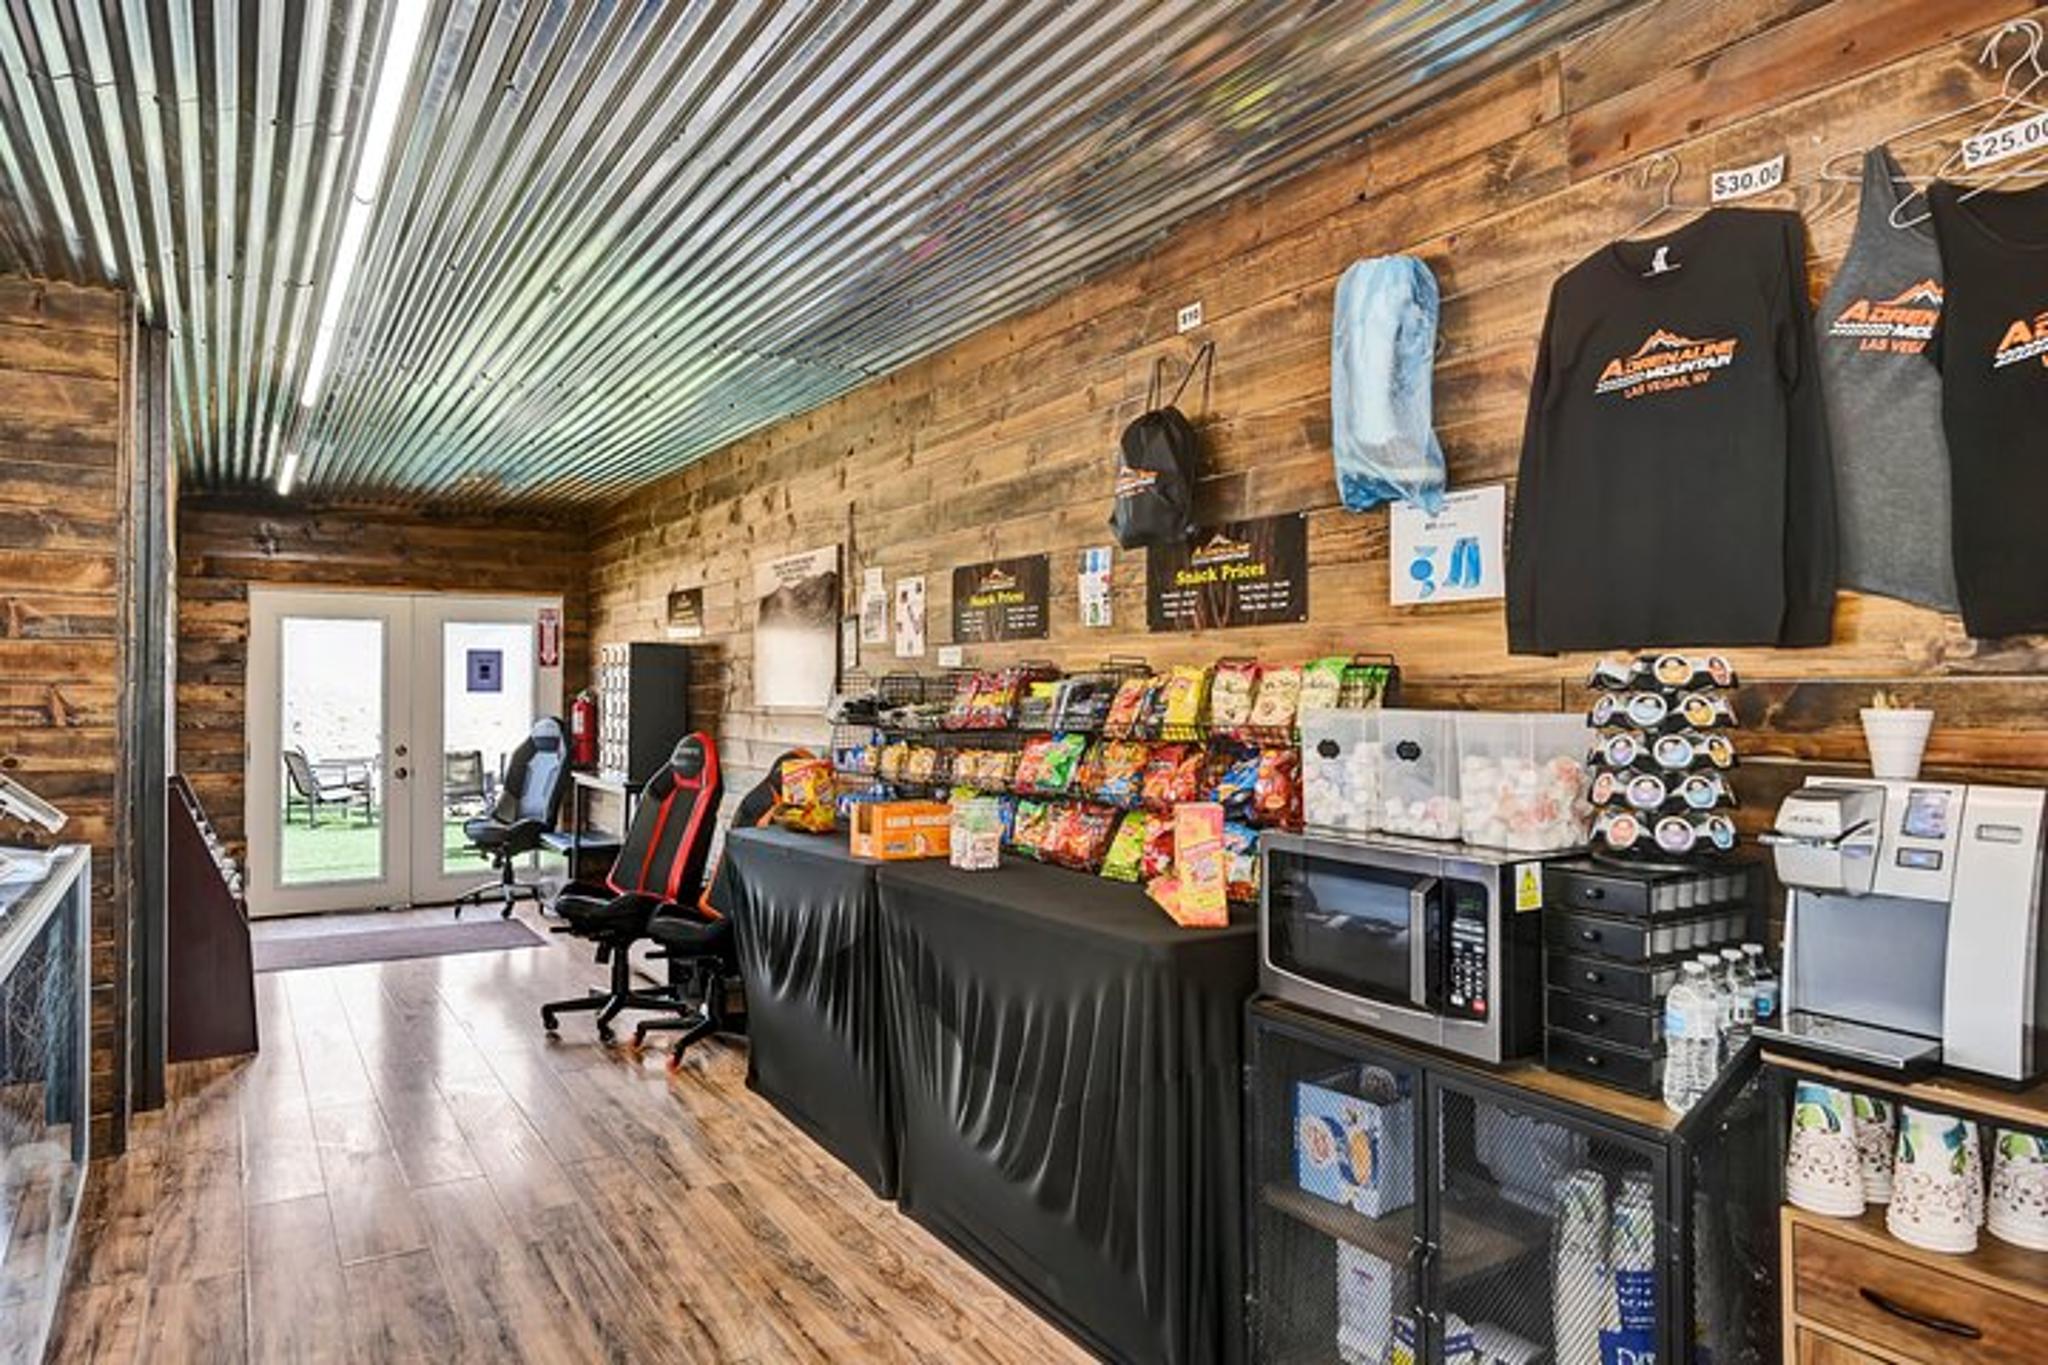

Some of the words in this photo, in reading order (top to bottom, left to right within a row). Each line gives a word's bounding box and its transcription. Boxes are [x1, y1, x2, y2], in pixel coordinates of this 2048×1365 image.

[1714, 162, 1779, 196] $30.00
[1859, 337, 1889, 351] LAS
[1175, 566, 1218, 586] Snack
[1222, 562, 1267, 581] Prices
